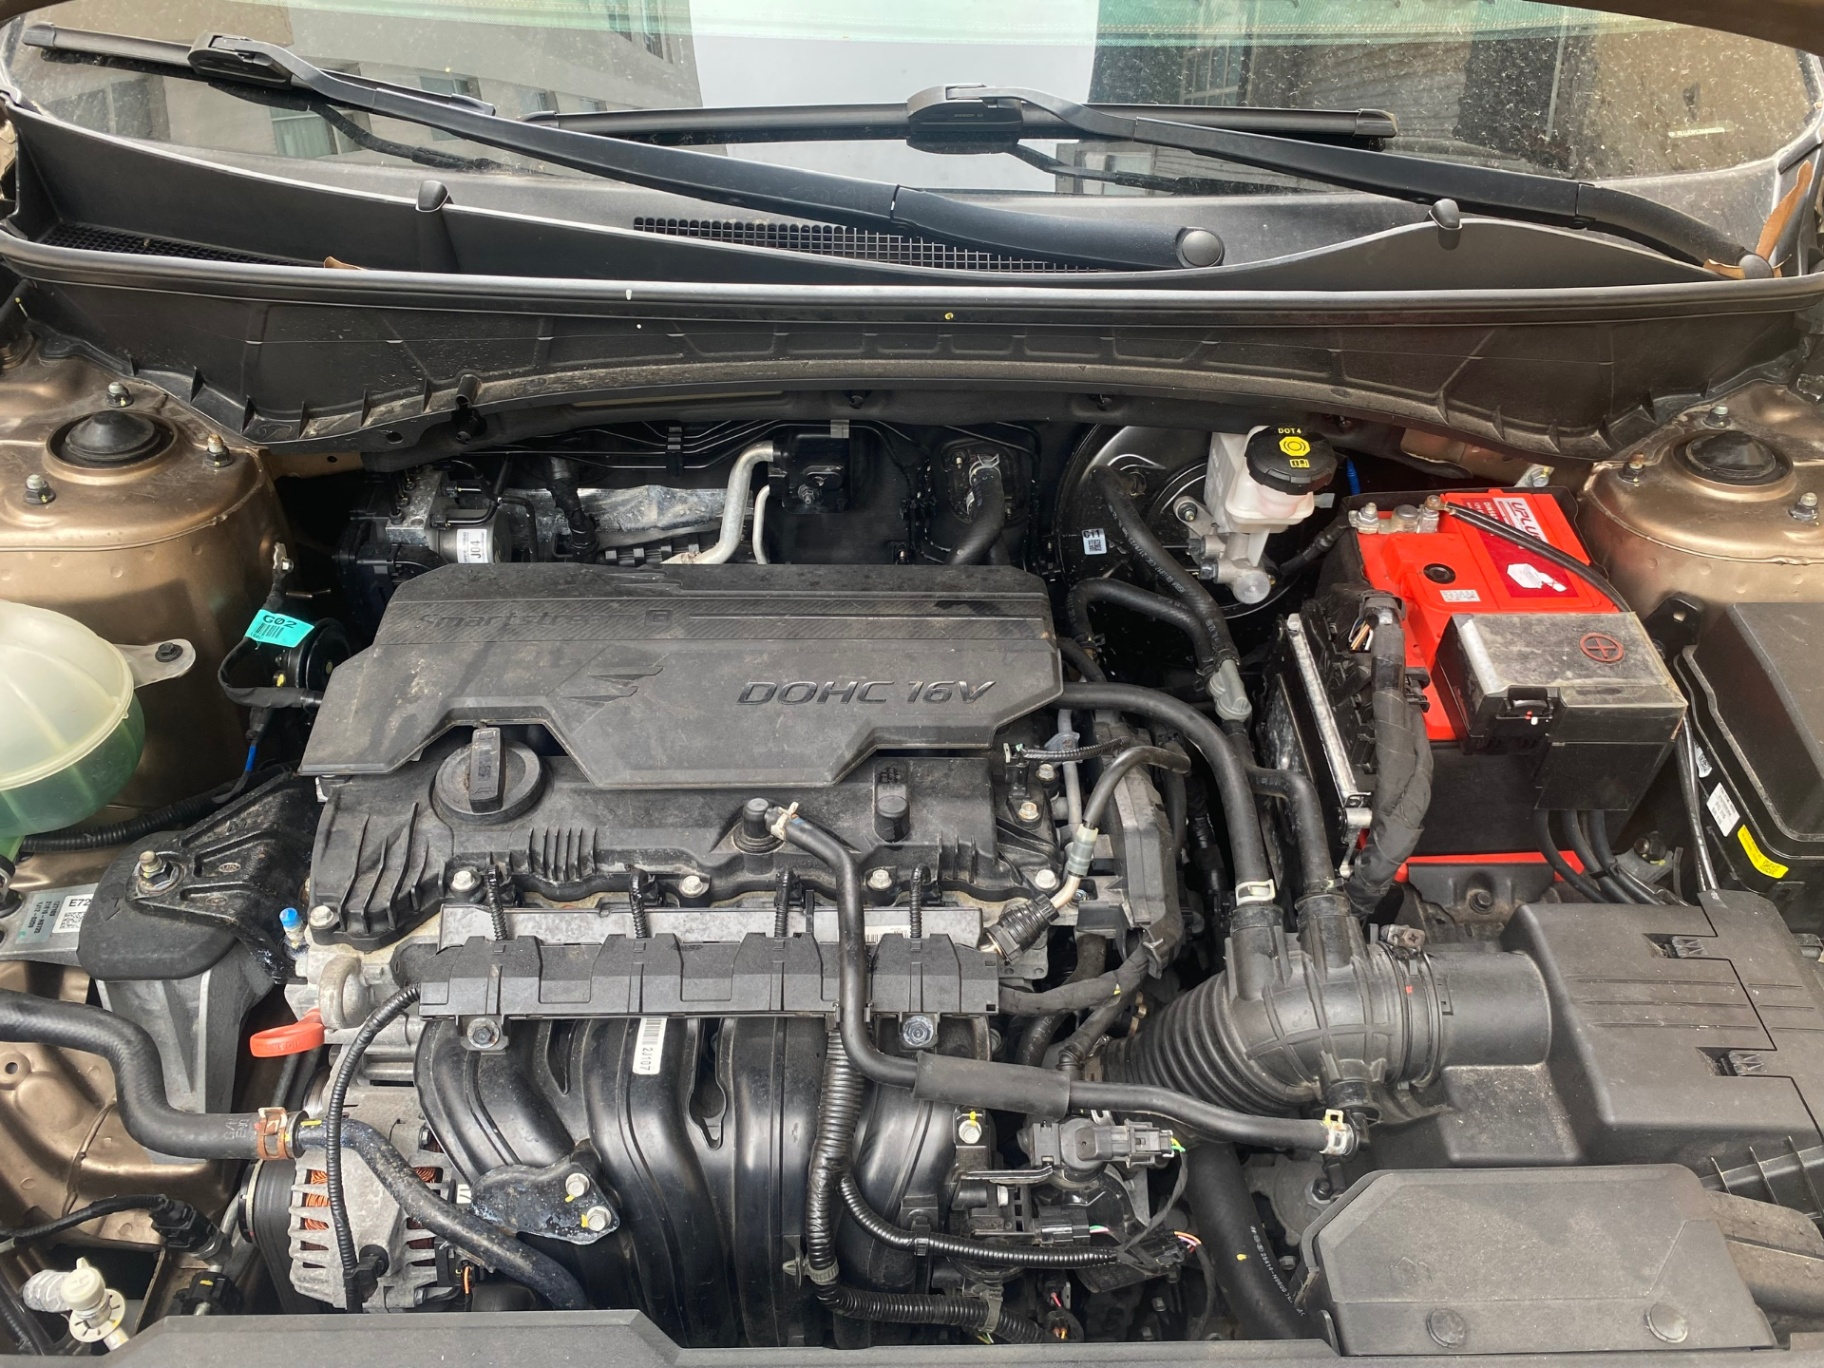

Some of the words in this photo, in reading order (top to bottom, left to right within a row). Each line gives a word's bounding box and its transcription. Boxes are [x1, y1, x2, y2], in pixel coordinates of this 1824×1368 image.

[470, 540, 482, 559] J04
[262, 614, 297, 629] G02
[735, 681, 895, 706] DOHC
[906, 680, 997, 705] 16V
